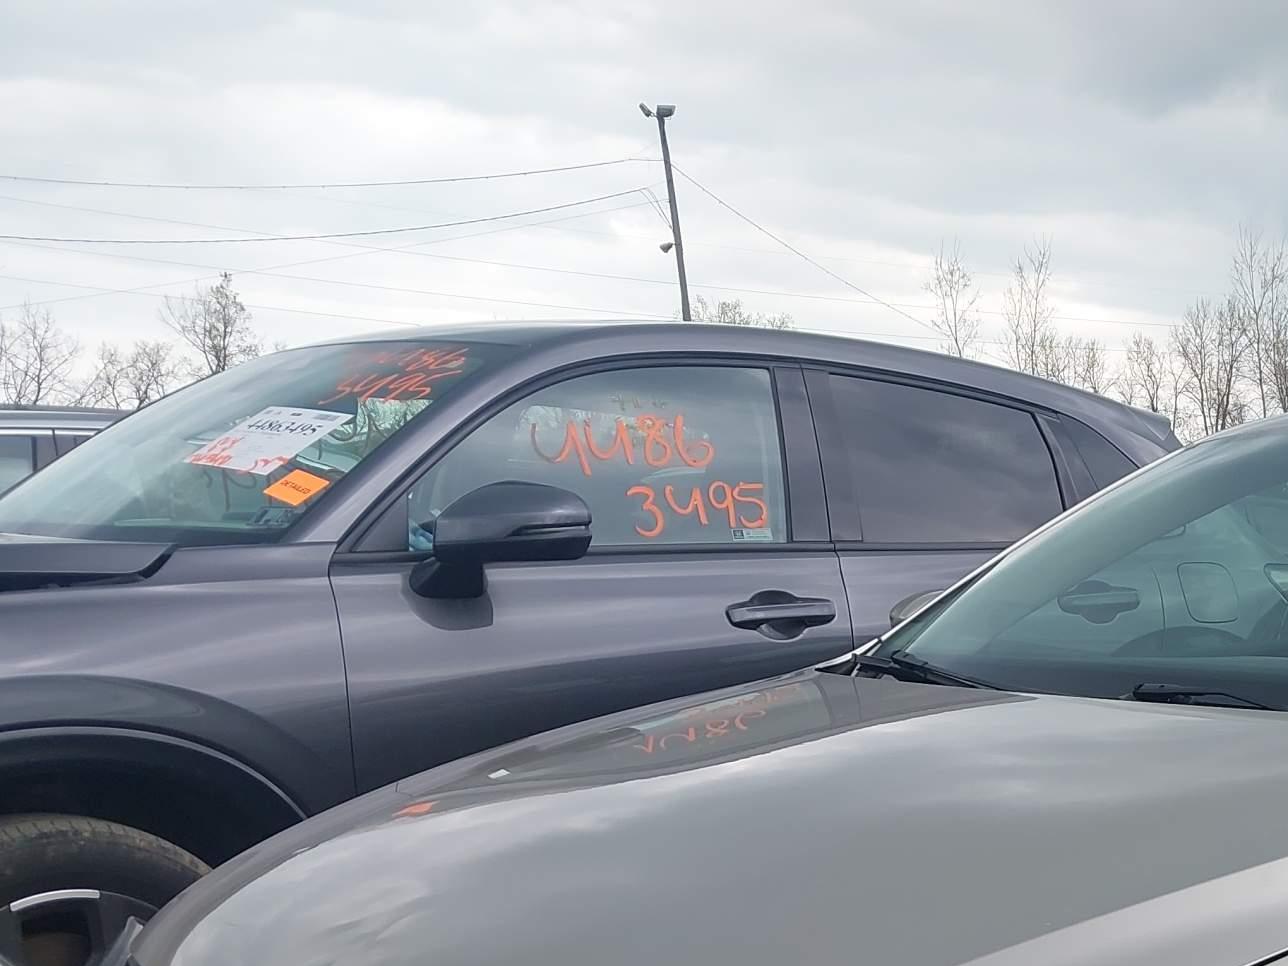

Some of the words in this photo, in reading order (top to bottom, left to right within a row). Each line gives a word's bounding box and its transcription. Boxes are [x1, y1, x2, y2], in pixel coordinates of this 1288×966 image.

[247, 418, 323, 436] 44863495
[280, 479, 312, 495] DETAILED
[626, 480, 768, 538] 3495
